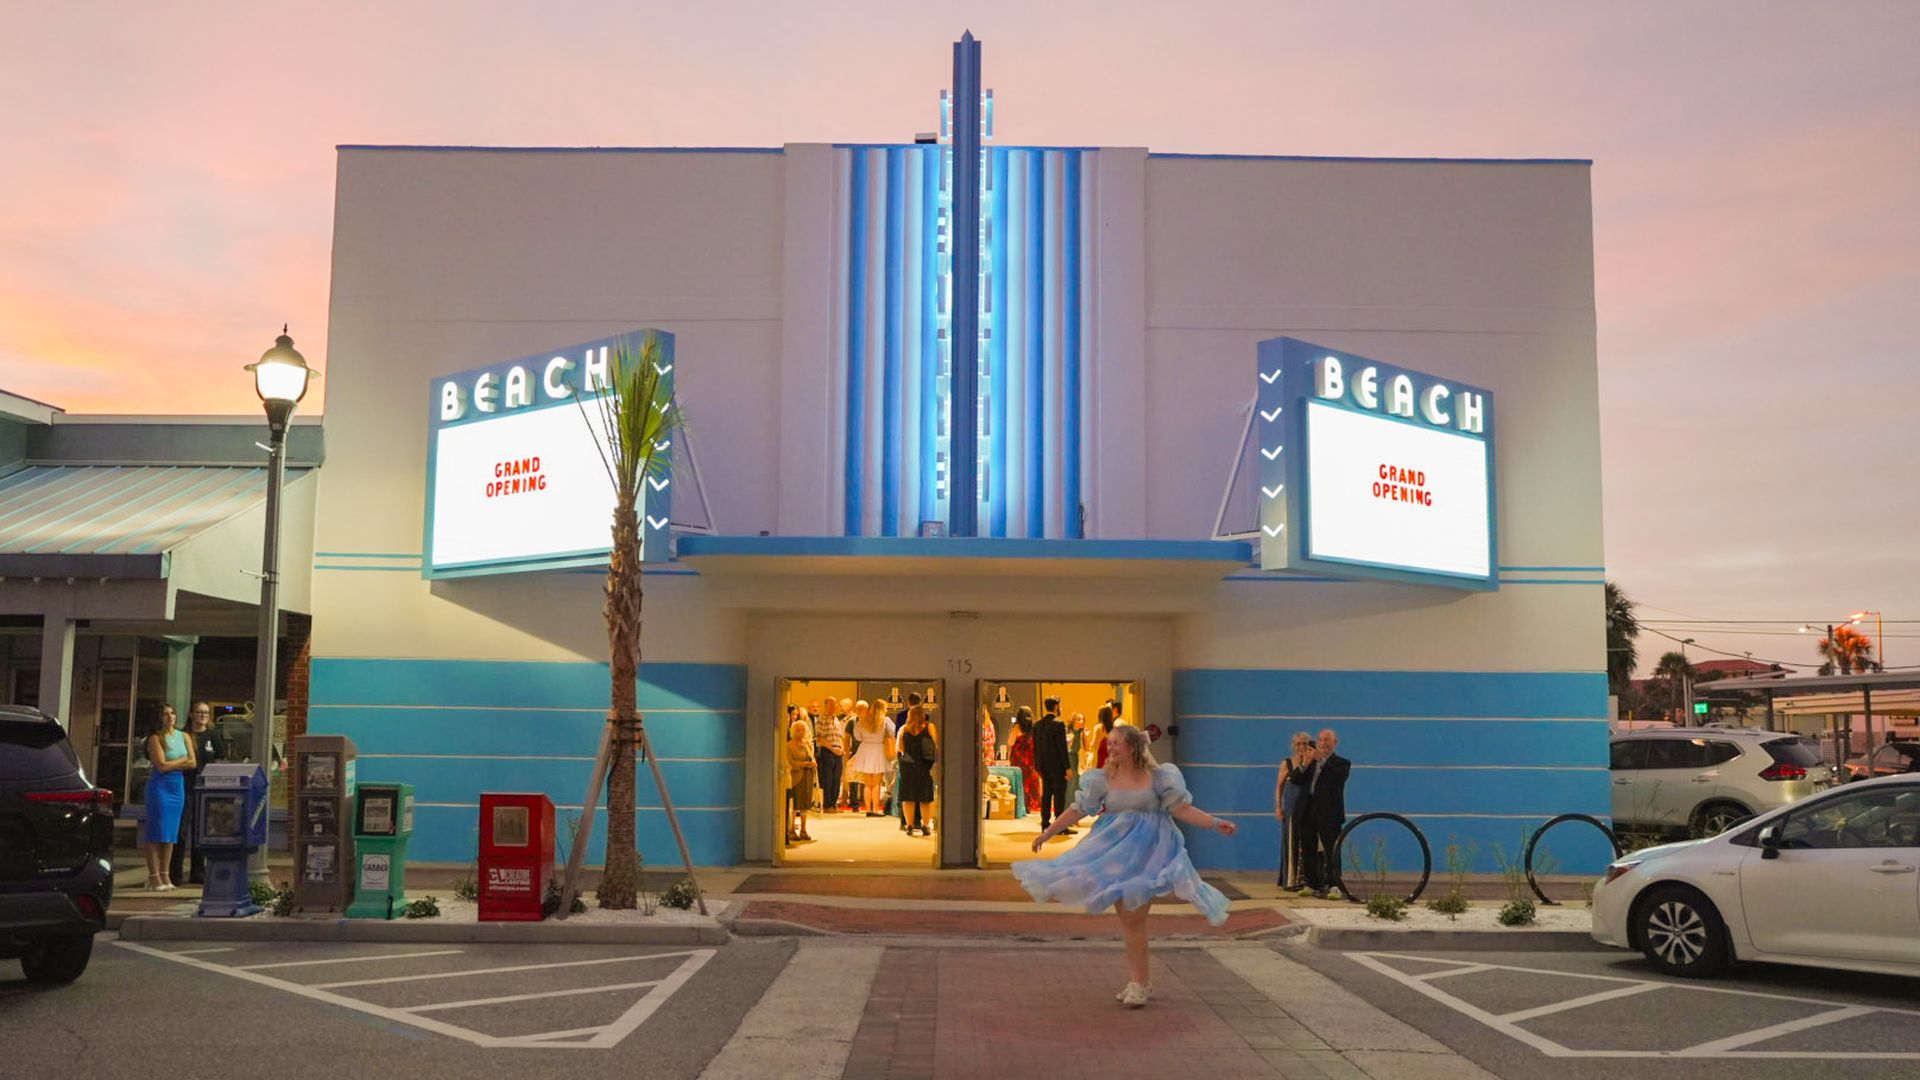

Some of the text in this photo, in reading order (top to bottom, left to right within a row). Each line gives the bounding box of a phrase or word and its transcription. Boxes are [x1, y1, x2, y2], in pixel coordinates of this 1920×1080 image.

[440, 345, 612, 421] BEACH
[1314, 356, 1484, 433] BEACH
[494, 456, 541, 478] GRAND
[1379, 464, 1426, 487] GRAND
[486, 475, 547, 498] OPENING
[1372, 481, 1433, 507] OPENING
